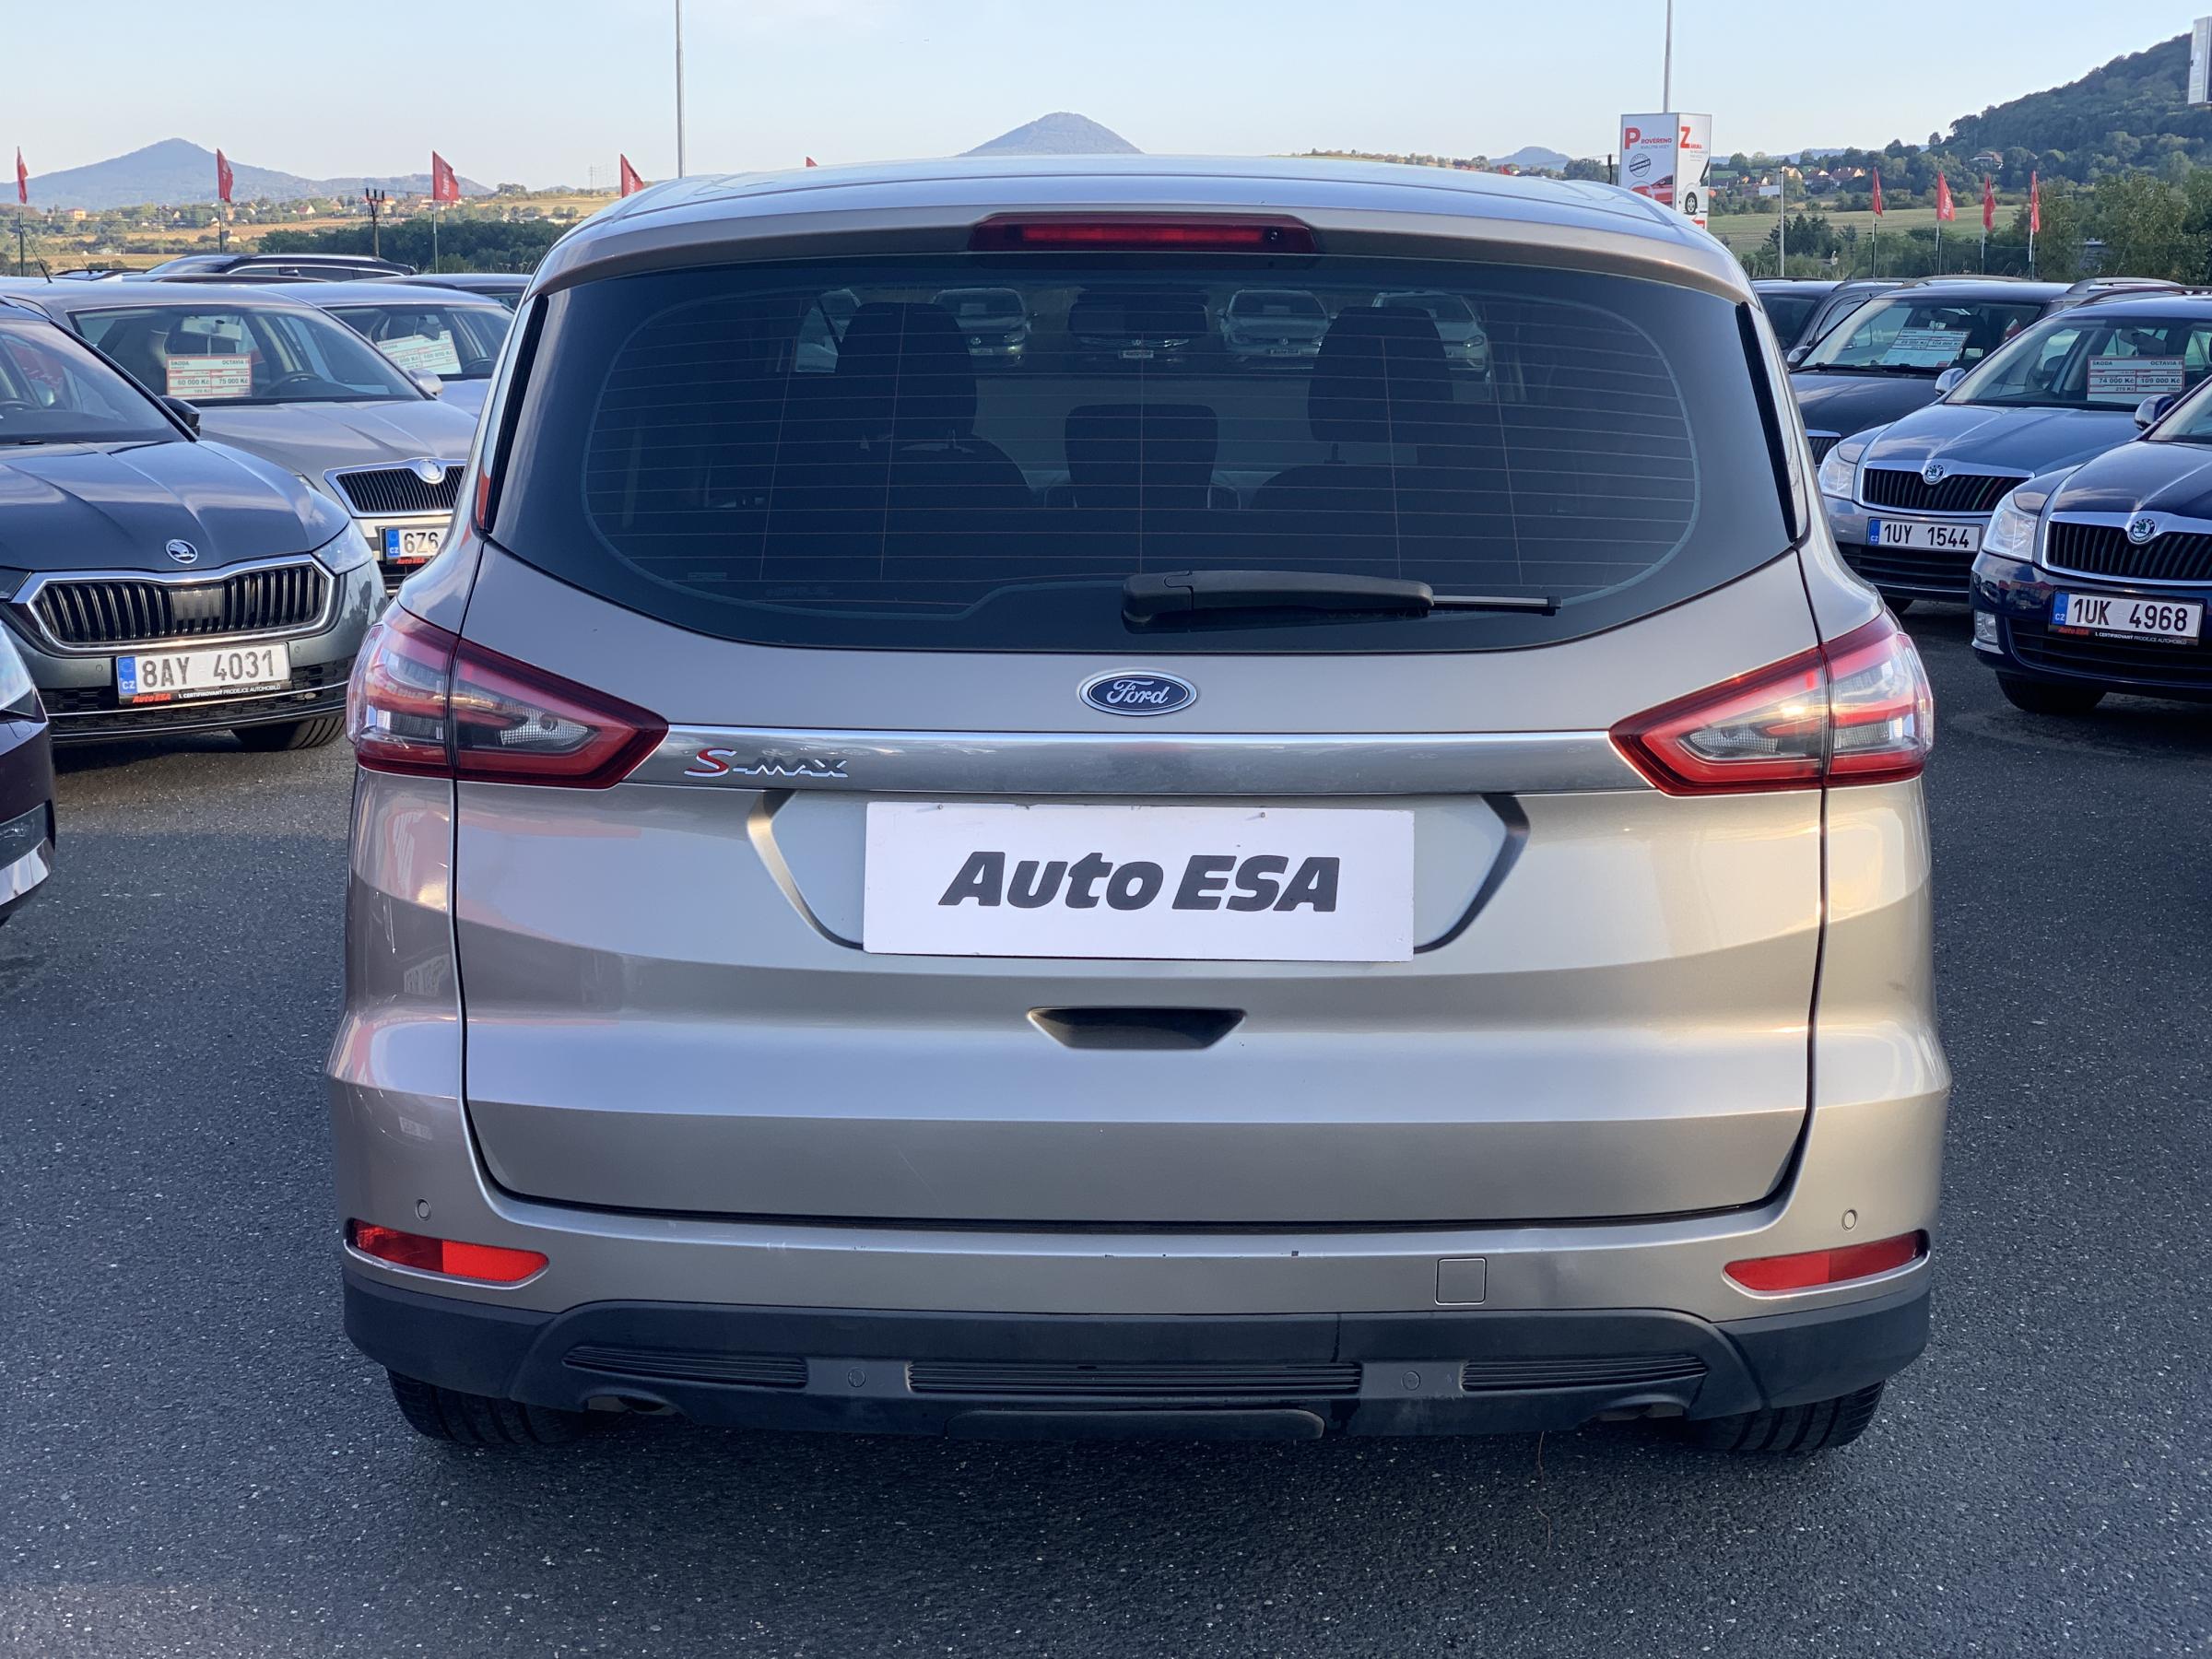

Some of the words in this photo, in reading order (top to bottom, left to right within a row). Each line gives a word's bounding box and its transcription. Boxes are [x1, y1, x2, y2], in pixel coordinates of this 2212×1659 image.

[1884, 524, 1912, 544] 1UY
[1927, 526, 1969, 548] 1544
[2055, 613, 2065, 621] CZ
[2074, 598, 2112, 625] 1UK
[2129, 604, 2188, 631] 4968
[142, 657, 190, 688] 8AY
[213, 650, 274, 680] 4031
[122, 681, 135, 689] CZ
[1106, 679, 1171, 704] Ford
[133, 695, 154, 703] Auto
[684, 747, 848, 778] S-MAX
[937, 851, 1164, 910] Auto
[1172, 854, 1340, 912] ESA
